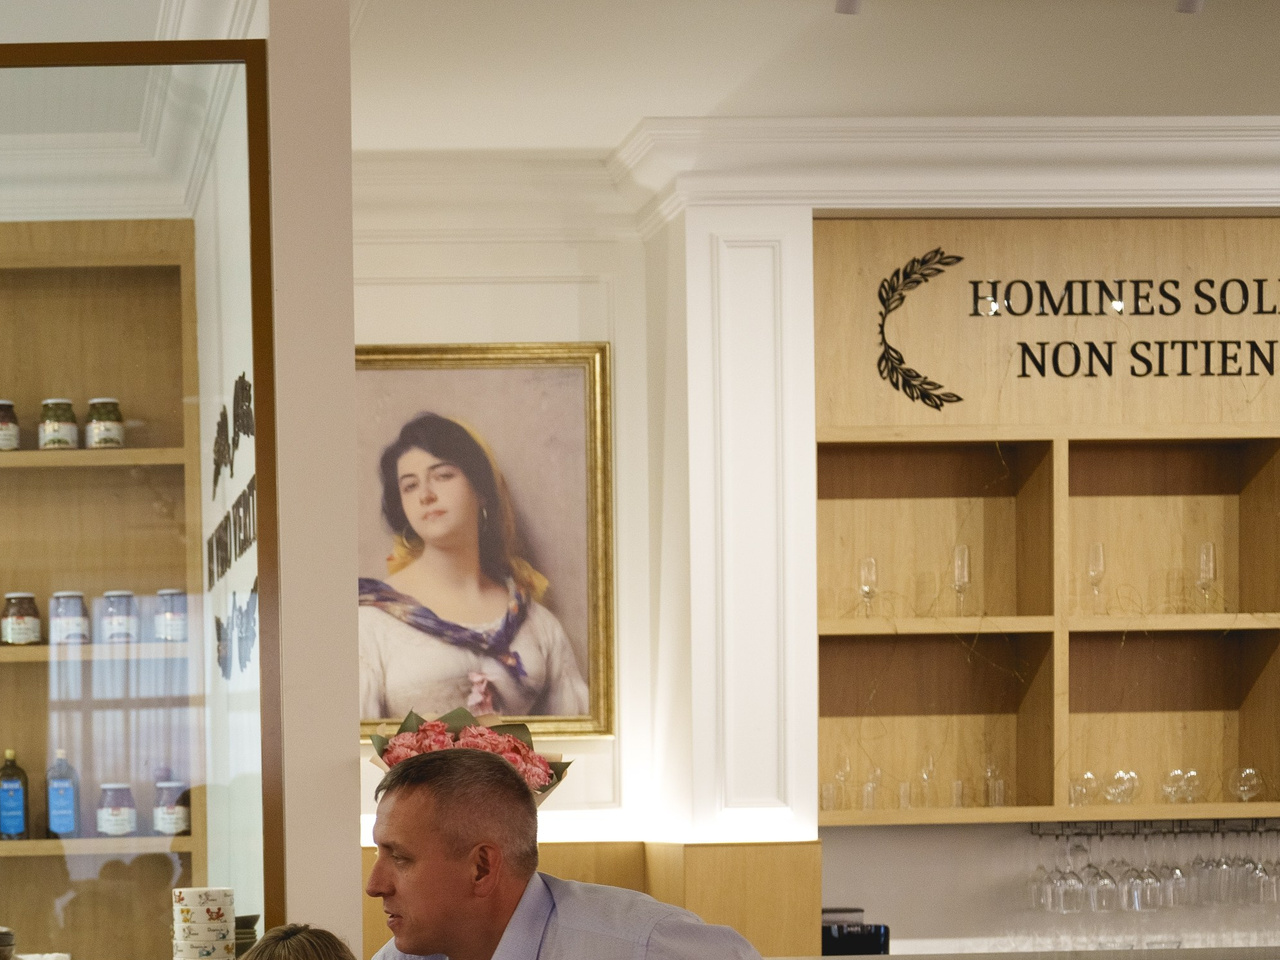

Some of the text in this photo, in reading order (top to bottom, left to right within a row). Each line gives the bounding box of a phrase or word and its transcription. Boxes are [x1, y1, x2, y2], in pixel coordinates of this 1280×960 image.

[969, 278, 1280, 316] HOMINES SOL
[1018, 341, 1116, 377] NON
